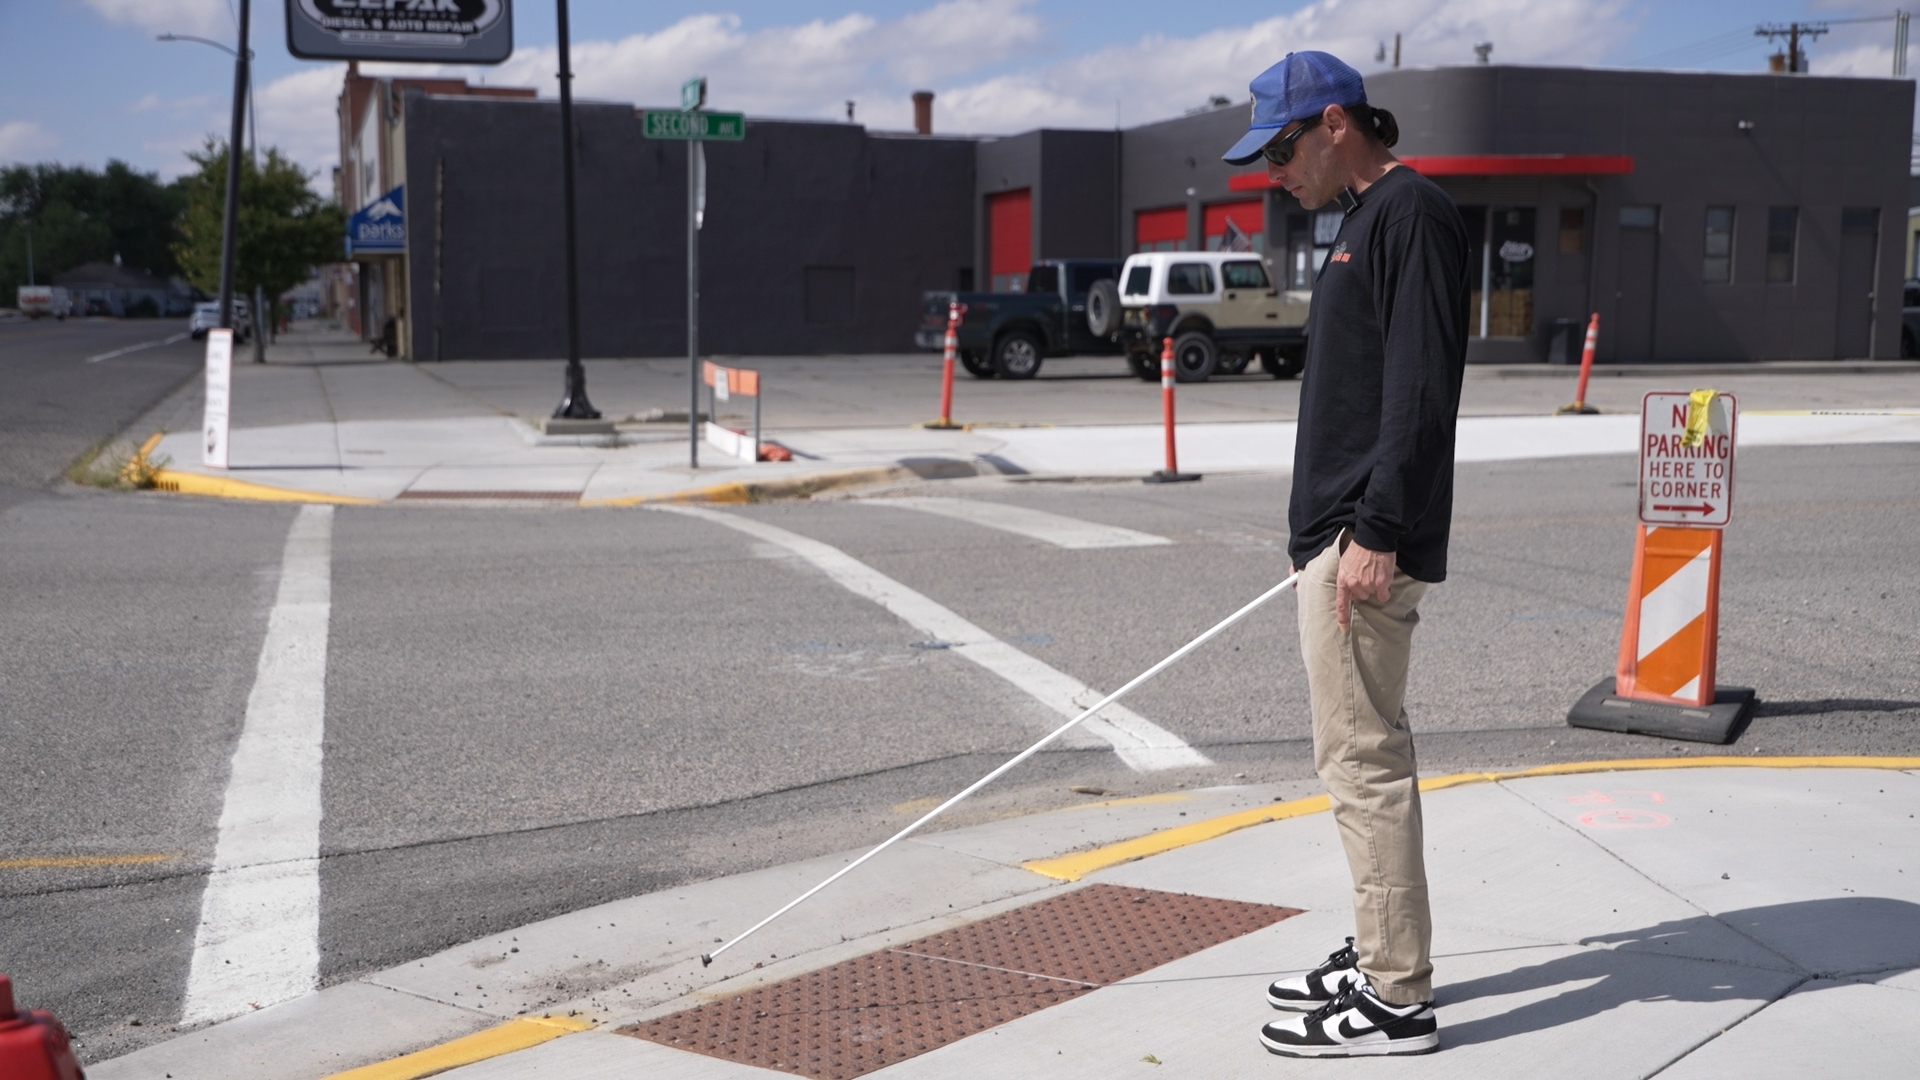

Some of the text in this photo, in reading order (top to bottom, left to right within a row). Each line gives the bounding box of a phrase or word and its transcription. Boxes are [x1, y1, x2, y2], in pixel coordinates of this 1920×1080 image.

[322, 16, 474, 33] DIESEL & AUTO REPAIR
[652, 114, 736, 136] SECOND AVE
[358, 220, 404, 241] parks
[1650, 461, 1724, 479] HERE TO
[1651, 481, 1721, 499] CORNER
